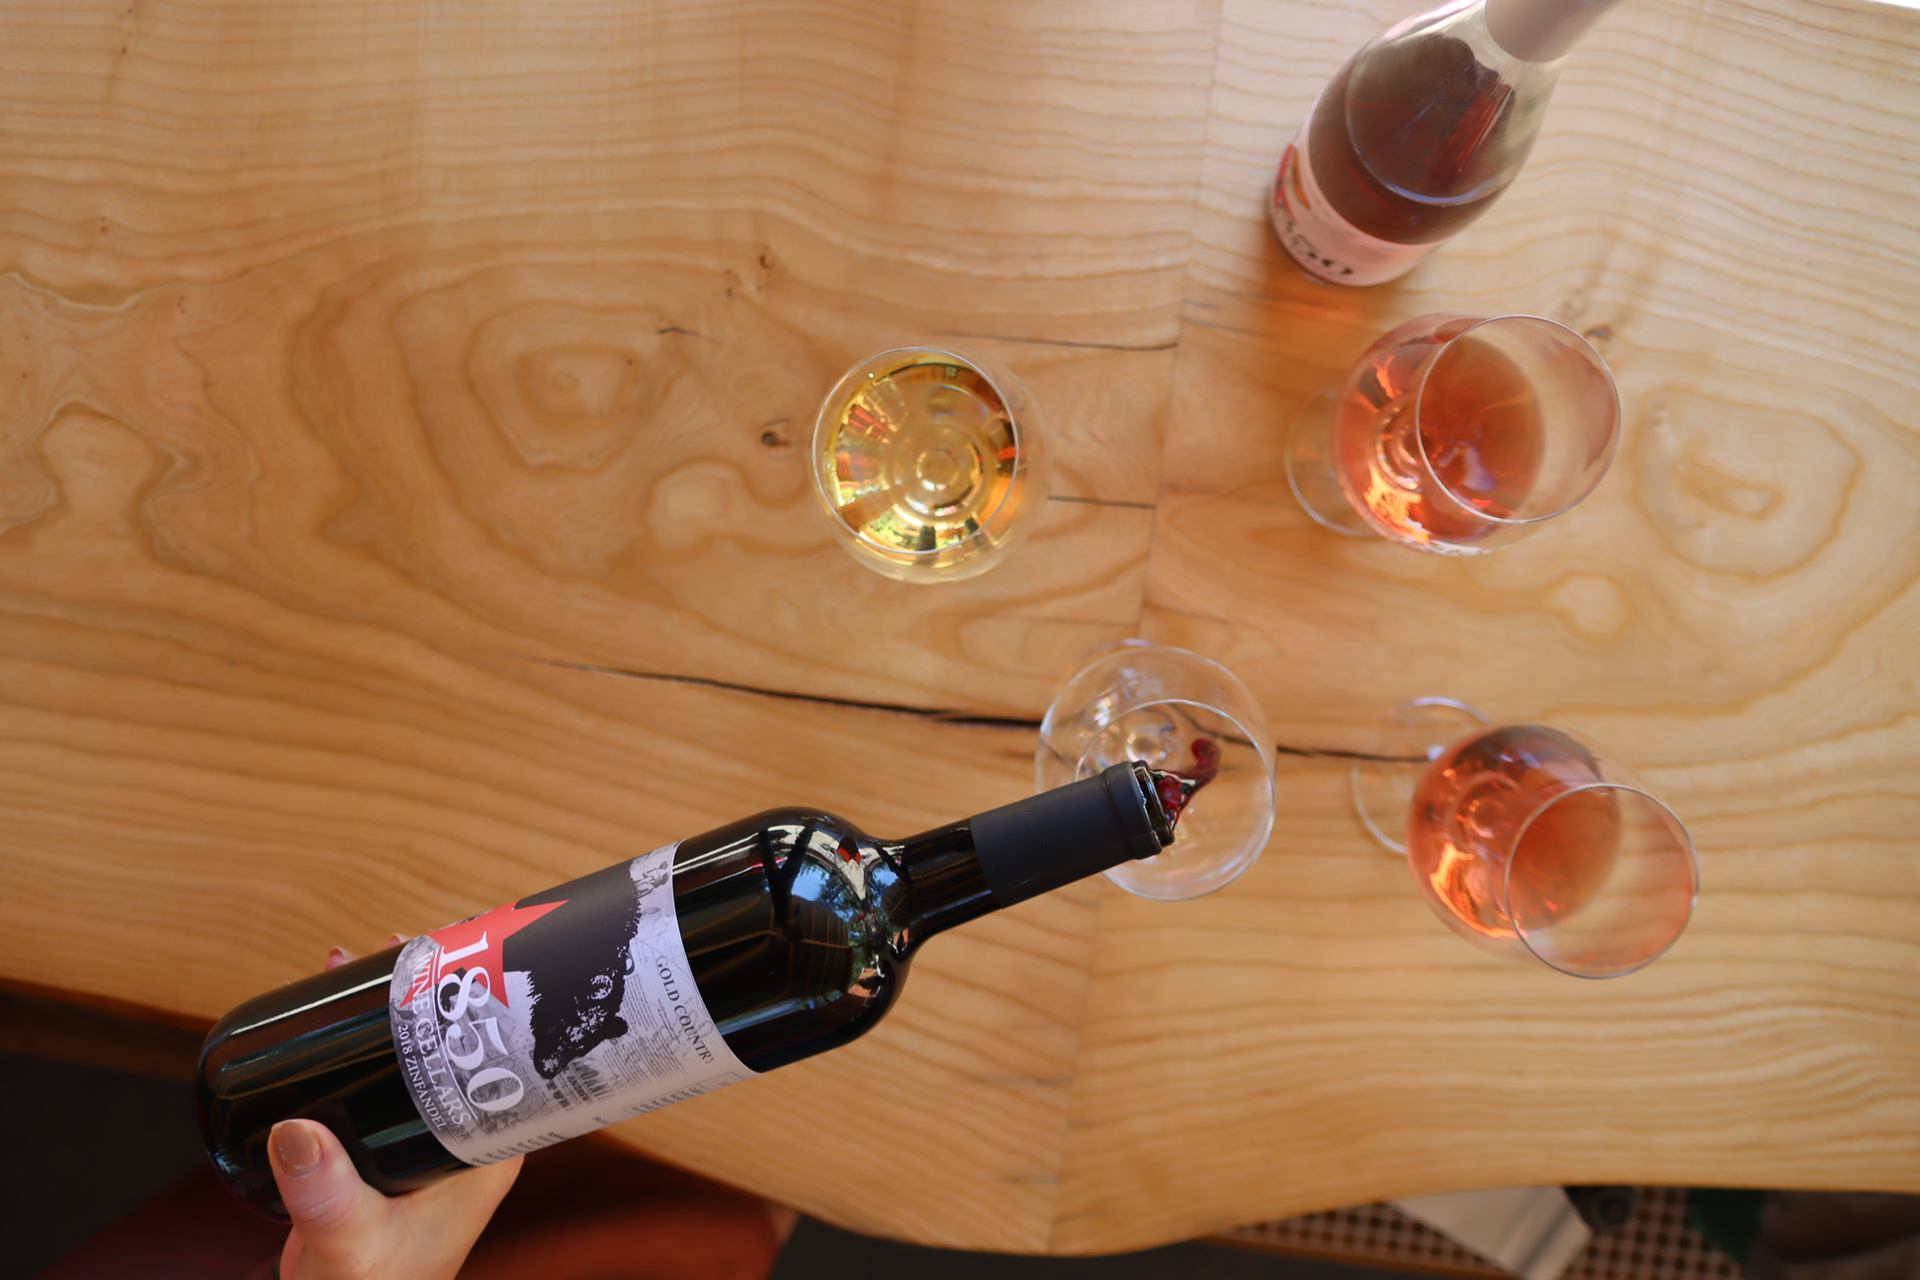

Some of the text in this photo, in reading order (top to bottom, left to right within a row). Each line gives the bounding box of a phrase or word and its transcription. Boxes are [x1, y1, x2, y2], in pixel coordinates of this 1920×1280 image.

[412, 951, 434, 1014] WINE
[437, 931, 524, 1112] 1850
[656, 956, 680, 1002] GOLD
[398, 1026, 447, 1131] 2018 ZINFANDEL
[415, 1018, 472, 1125] CELLARS
